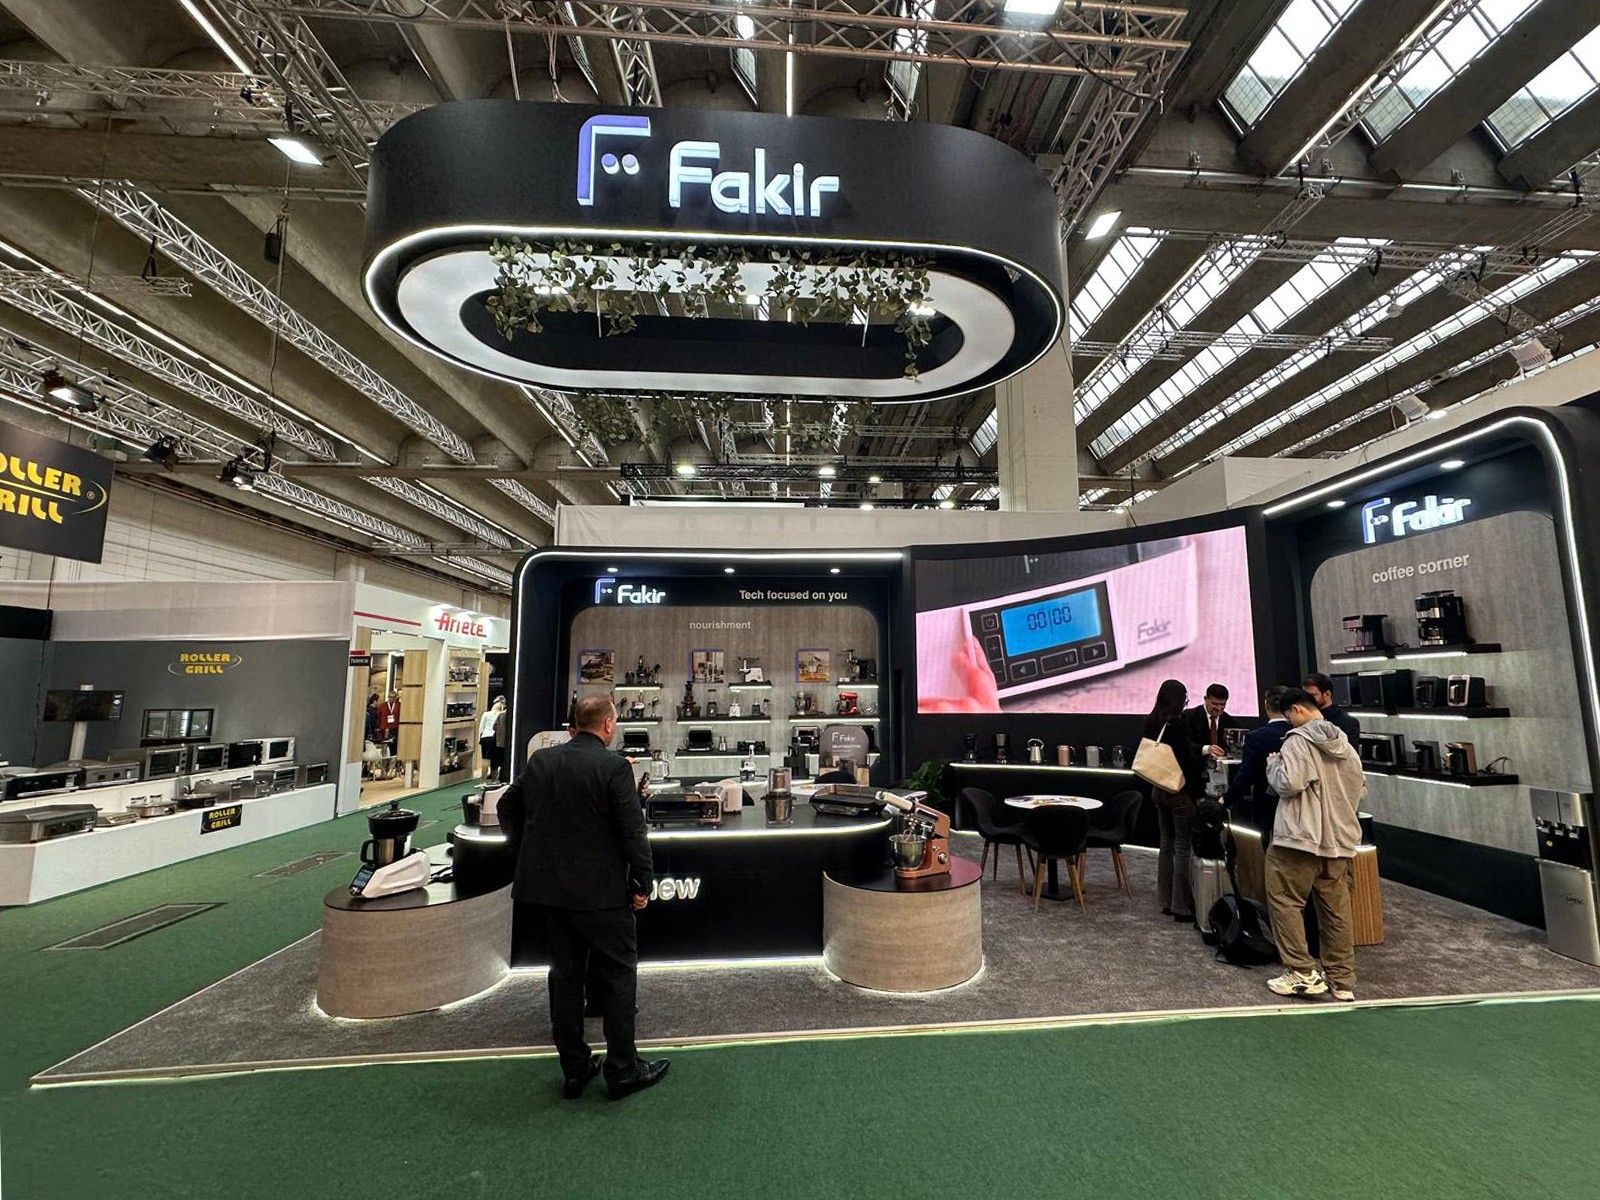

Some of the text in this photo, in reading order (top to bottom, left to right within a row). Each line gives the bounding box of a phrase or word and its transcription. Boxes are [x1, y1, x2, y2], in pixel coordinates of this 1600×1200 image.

[669, 140, 840, 217] Fakir
[1392, 495, 1472, 536] Fakir
[1372, 554, 1470, 583] coffee corner
[617, 585, 666, 604] Fakir
[739, 589, 848, 602] Tech focused on you
[434, 610, 487, 638] Ariete
[689, 621, 751, 630] nourishment
[180, 653, 231, 662] ROLLER
[185, 665, 224, 674] GRILL
[209, 807, 236, 820] ROLLER
[211, 818, 232, 829] GRILL
